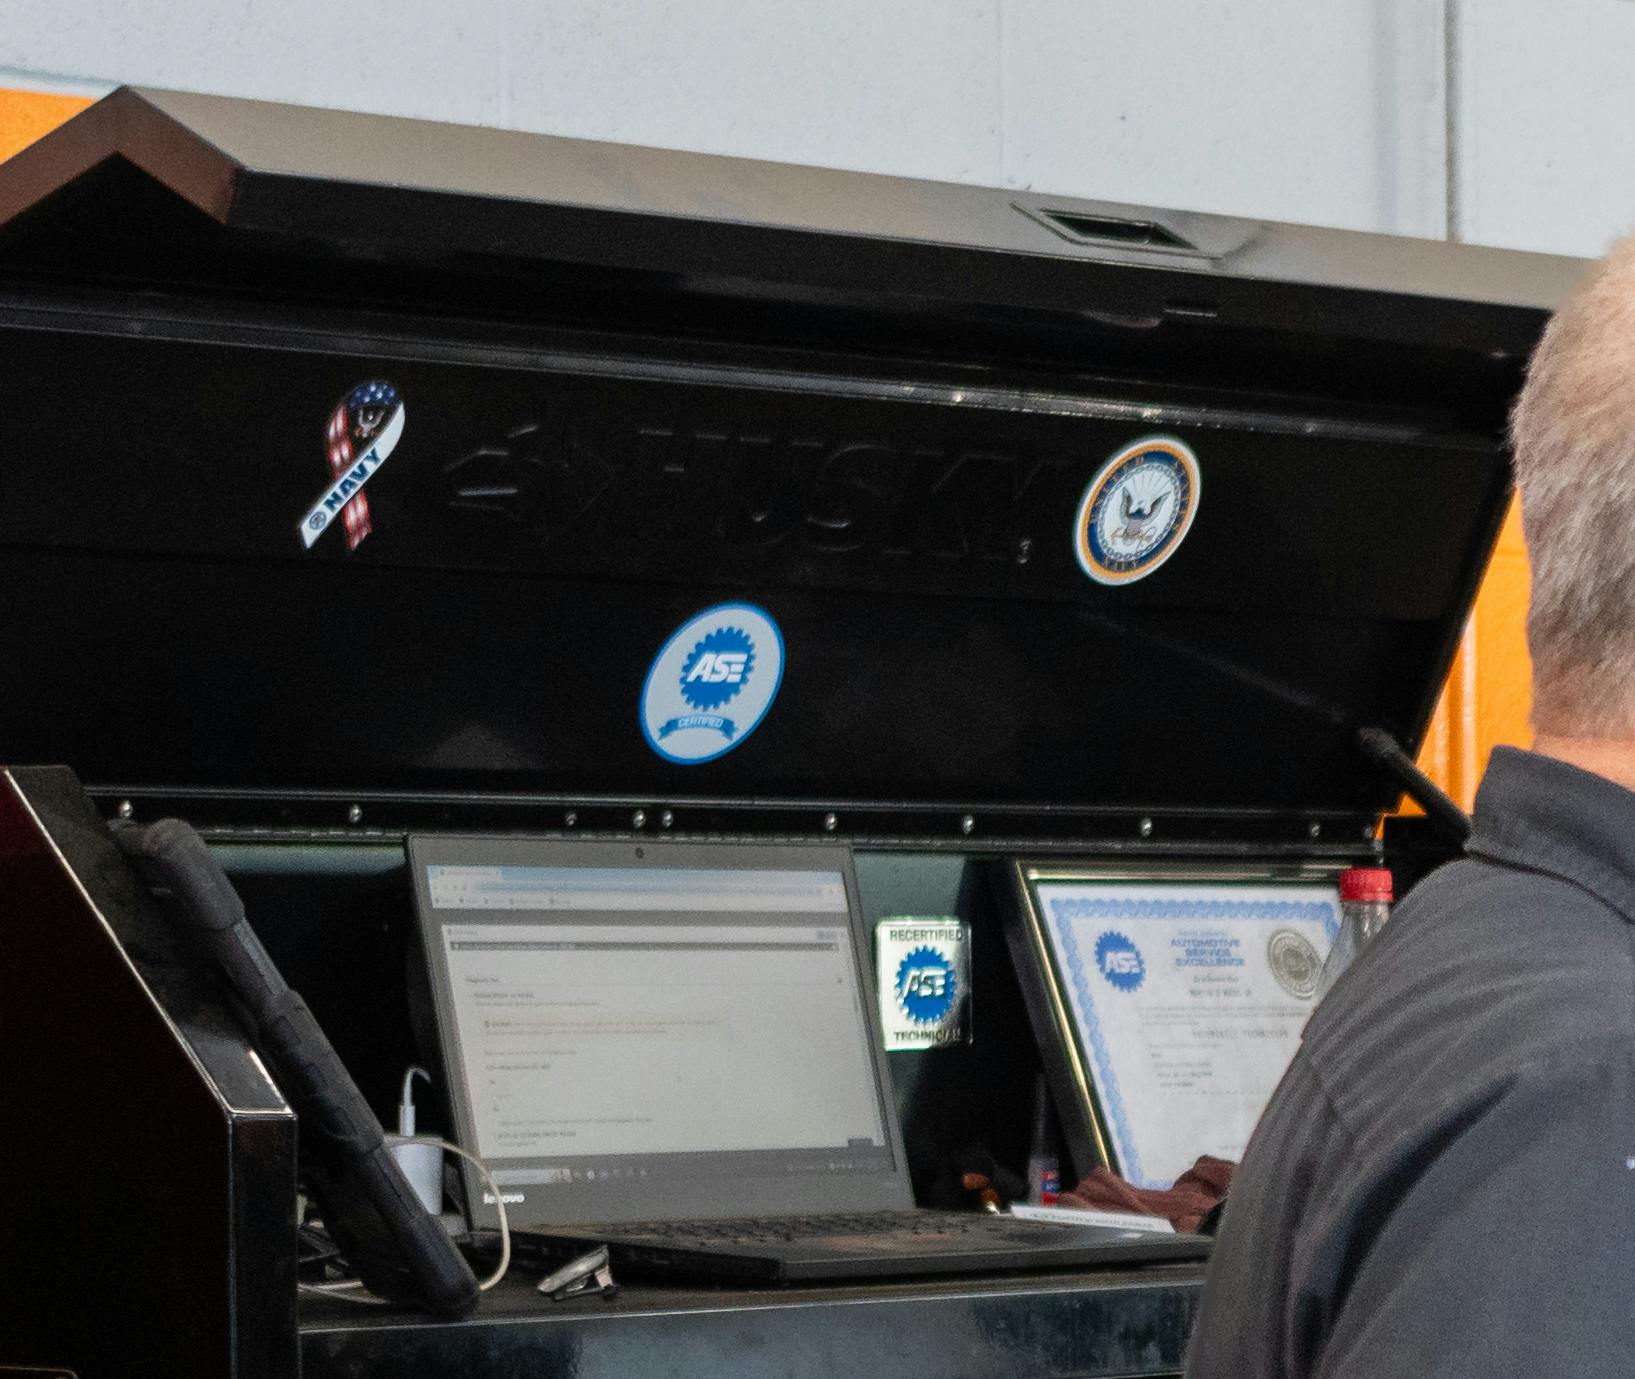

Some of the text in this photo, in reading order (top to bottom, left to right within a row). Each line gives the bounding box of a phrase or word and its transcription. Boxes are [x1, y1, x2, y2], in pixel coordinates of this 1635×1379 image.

[324, 448, 381, 513] NAVY
[687, 653, 748, 683] ASE
[678, 714, 724, 728] CERTIFIED
[890, 929, 964, 942] RECERTIFIED
[1170, 938, 1240, 948] AUTOMOTIVE
[1105, 951, 1143, 974] ASE
[901, 966, 947, 998] ASE
